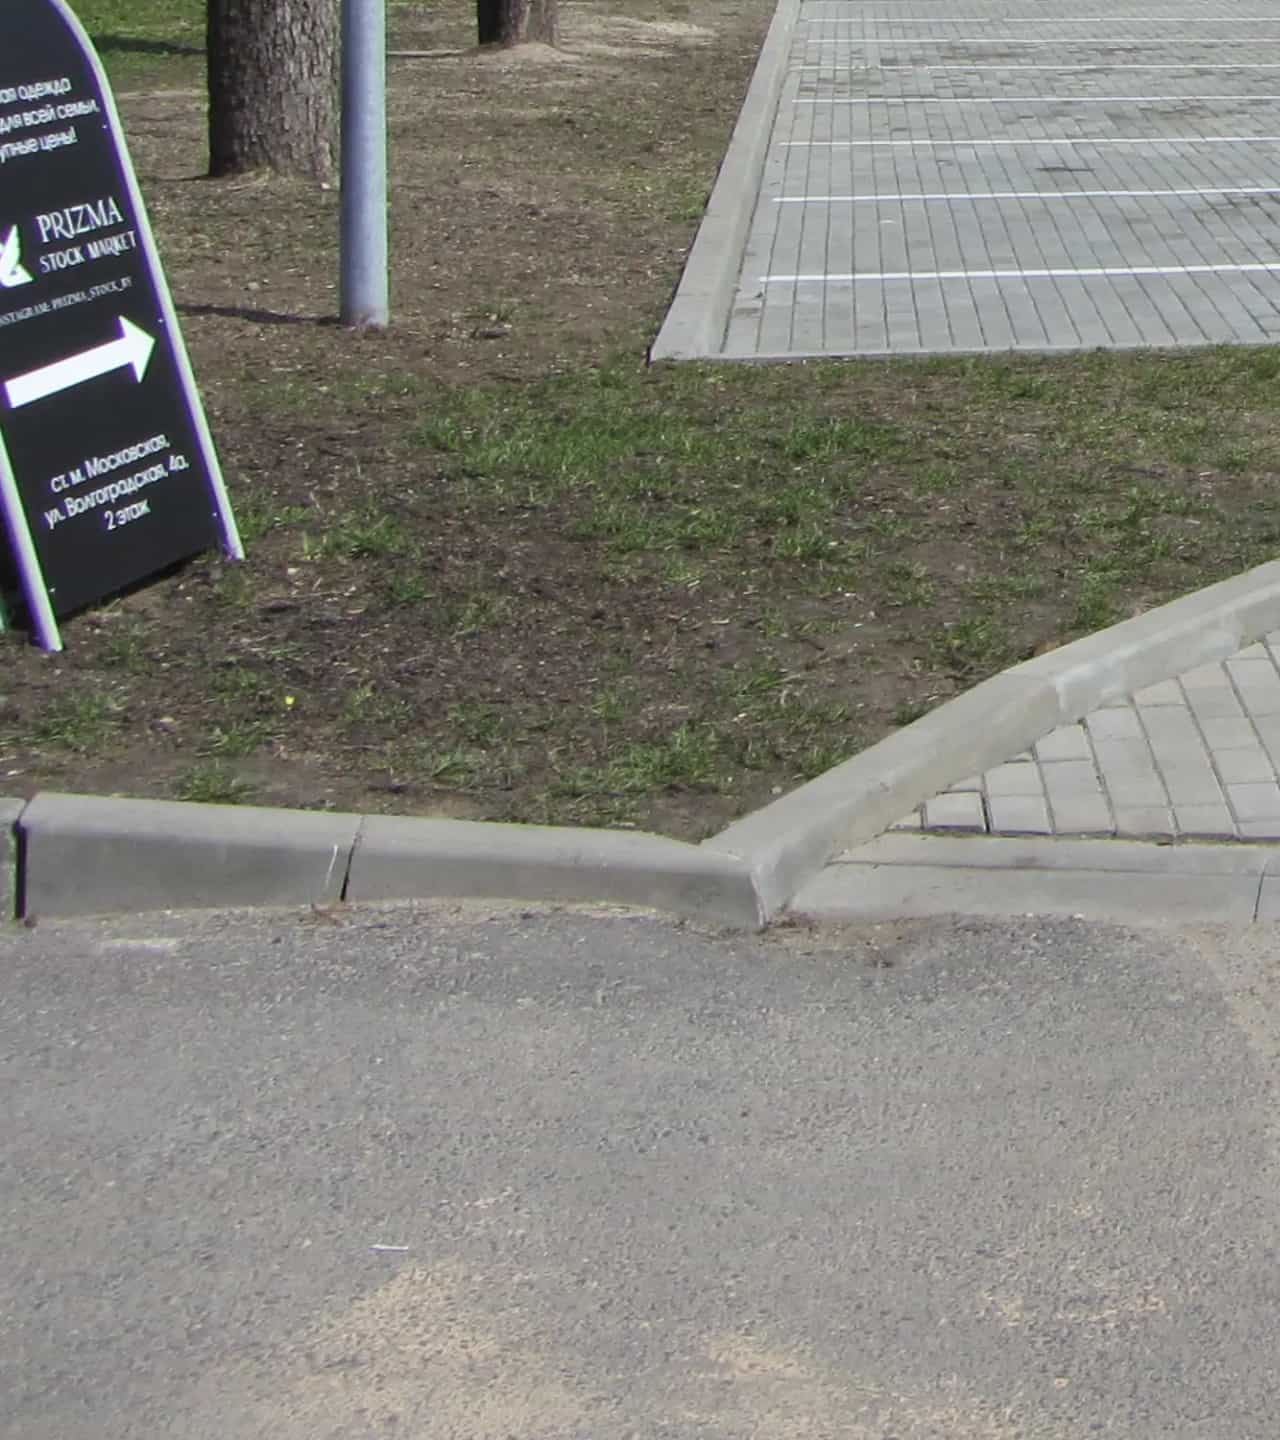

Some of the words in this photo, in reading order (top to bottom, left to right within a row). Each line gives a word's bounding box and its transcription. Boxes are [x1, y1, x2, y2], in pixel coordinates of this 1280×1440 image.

[18, 78, 72, 101] одежда
[22, 104, 57, 126] всей
[36, 197, 123, 243] PRIZMA
[40, 246, 86, 273] STOCK
[87, 230, 136, 259] MARKET
[104, 510, 117, 530] 2
[117, 499, 152, 524] этаж
